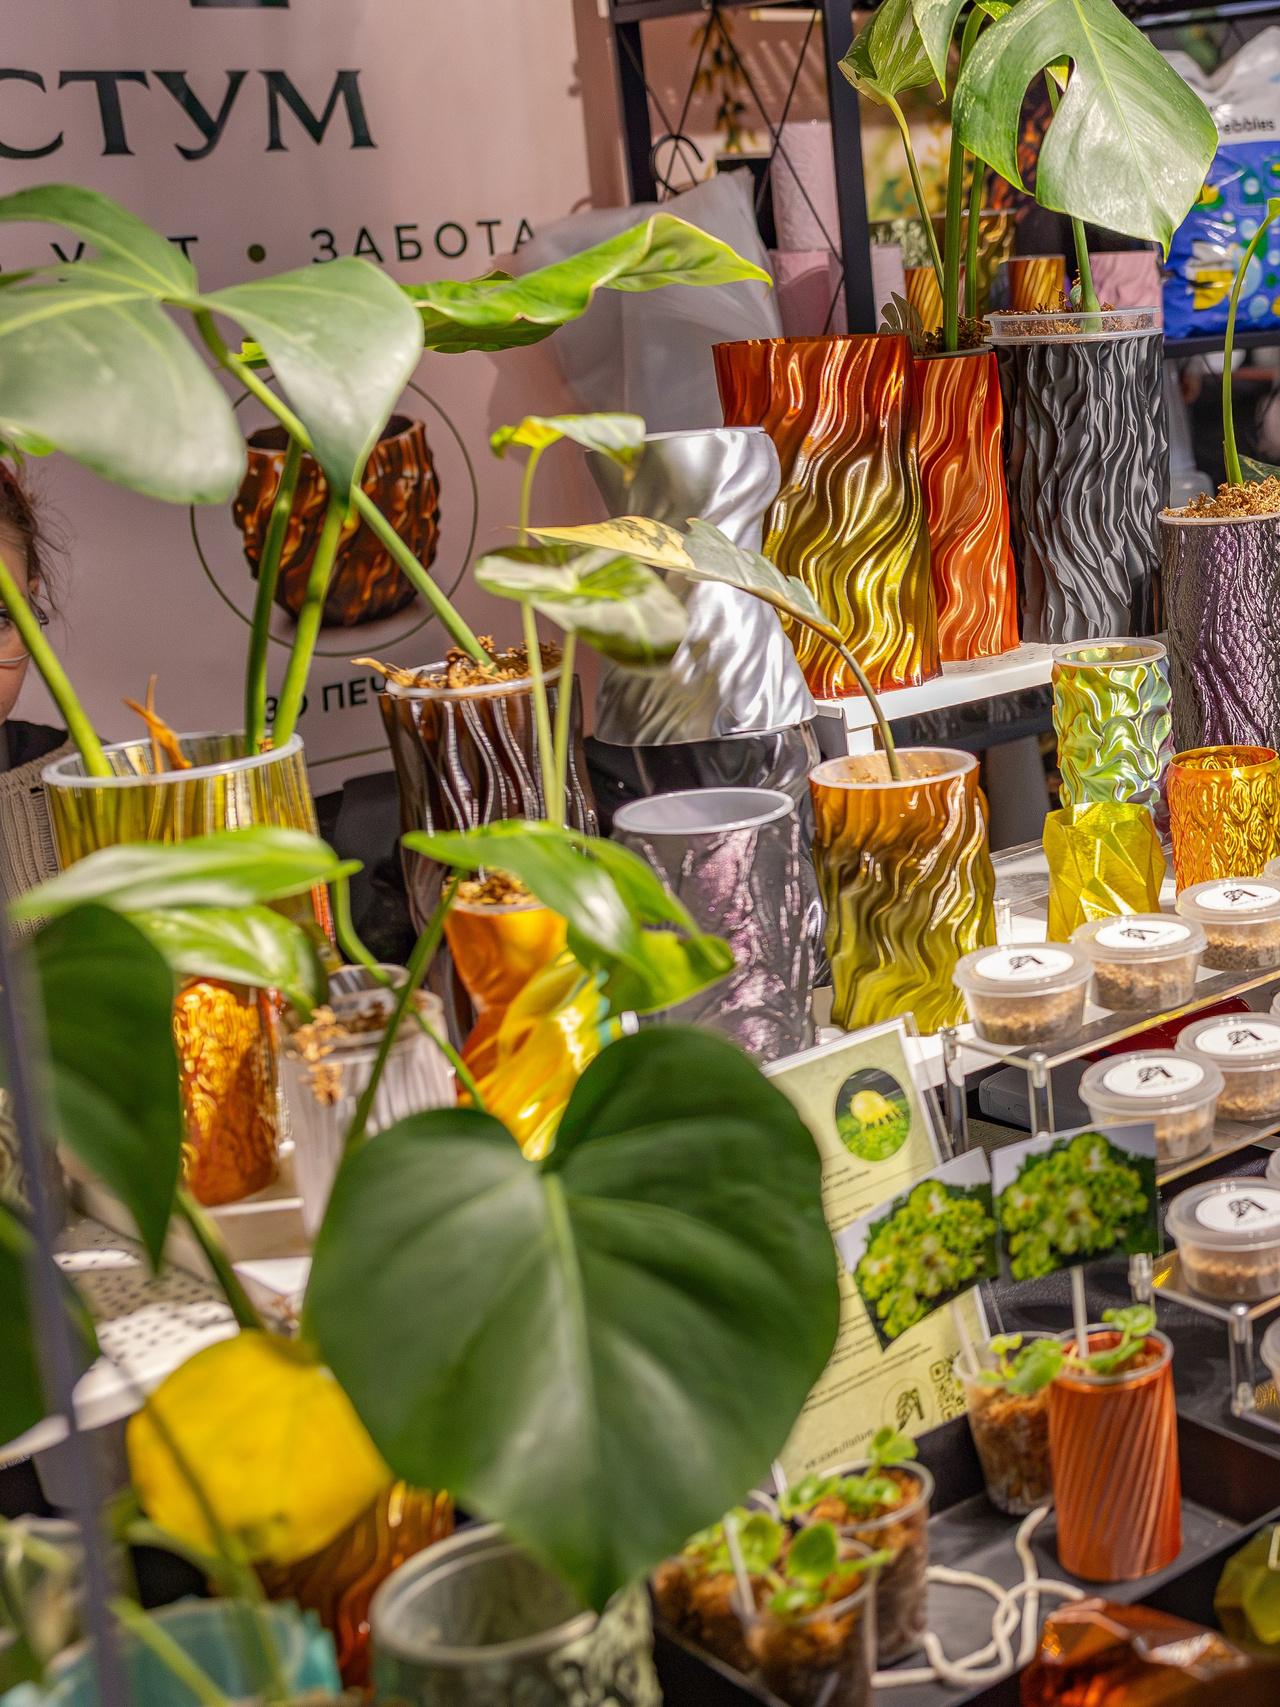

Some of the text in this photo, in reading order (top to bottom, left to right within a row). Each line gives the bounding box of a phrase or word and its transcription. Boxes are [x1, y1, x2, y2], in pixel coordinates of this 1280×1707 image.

[0, 68, 378, 161] СТУМ
[1219, 116, 1276, 135] ebbles
[310, 218, 535, 264] ЗАБОТА
